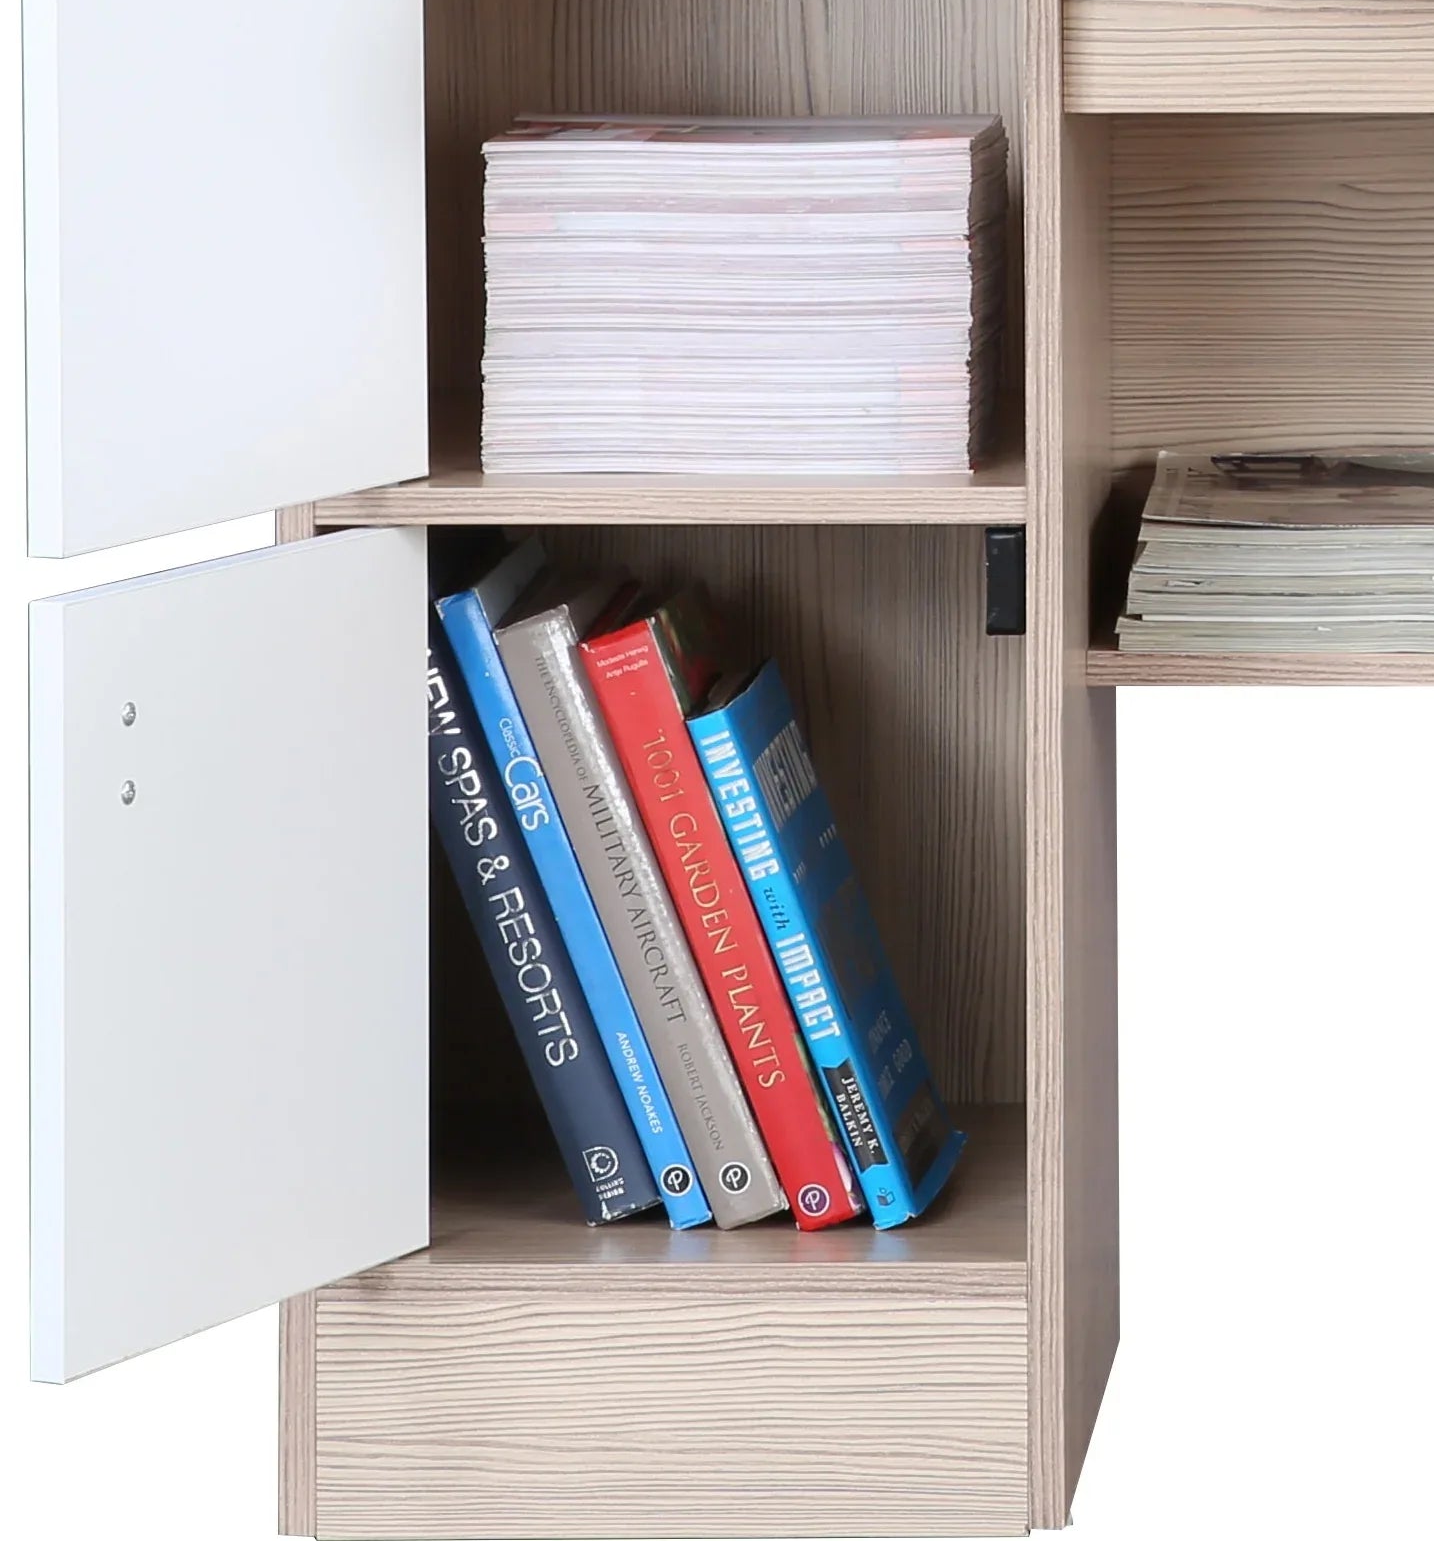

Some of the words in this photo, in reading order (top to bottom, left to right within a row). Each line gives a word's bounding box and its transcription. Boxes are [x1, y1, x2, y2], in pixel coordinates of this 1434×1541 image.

[428, 648, 462, 736] EW
[499, 717, 521, 758] Classic
[543, 679, 583, 767] ENCYCLOPEDIA
[437, 746, 499, 847] SPAS
[504, 756, 550, 832] Cars
[576, 765, 590, 782] OF
[700, 729, 781, 882] INVESTING
[476, 855, 510, 886] &
[582, 783, 643, 899] MILITARY
[643, 734, 685, 802] 1001
[669, 812, 739, 956] GARDEN
[721, 963, 786, 1088] PLANTS
[763, 885, 791, 931] with
[488, 886, 580, 1068] RESORTS
[626, 907, 688, 1025] AIRCRAFT
[775, 932, 841, 1041] IMPACT
[615, 1031, 644, 1084] ANDREW
[636, 1084, 664, 1135] NOAKES
[677, 1042, 703, 1091] ROBERT
[695, 1093, 725, 1152] JACKSON
[836, 1092, 864, 1149] BALKIN
[841, 1077, 874, 1135] JEREMY
[867, 1138, 880, 1155] K.
